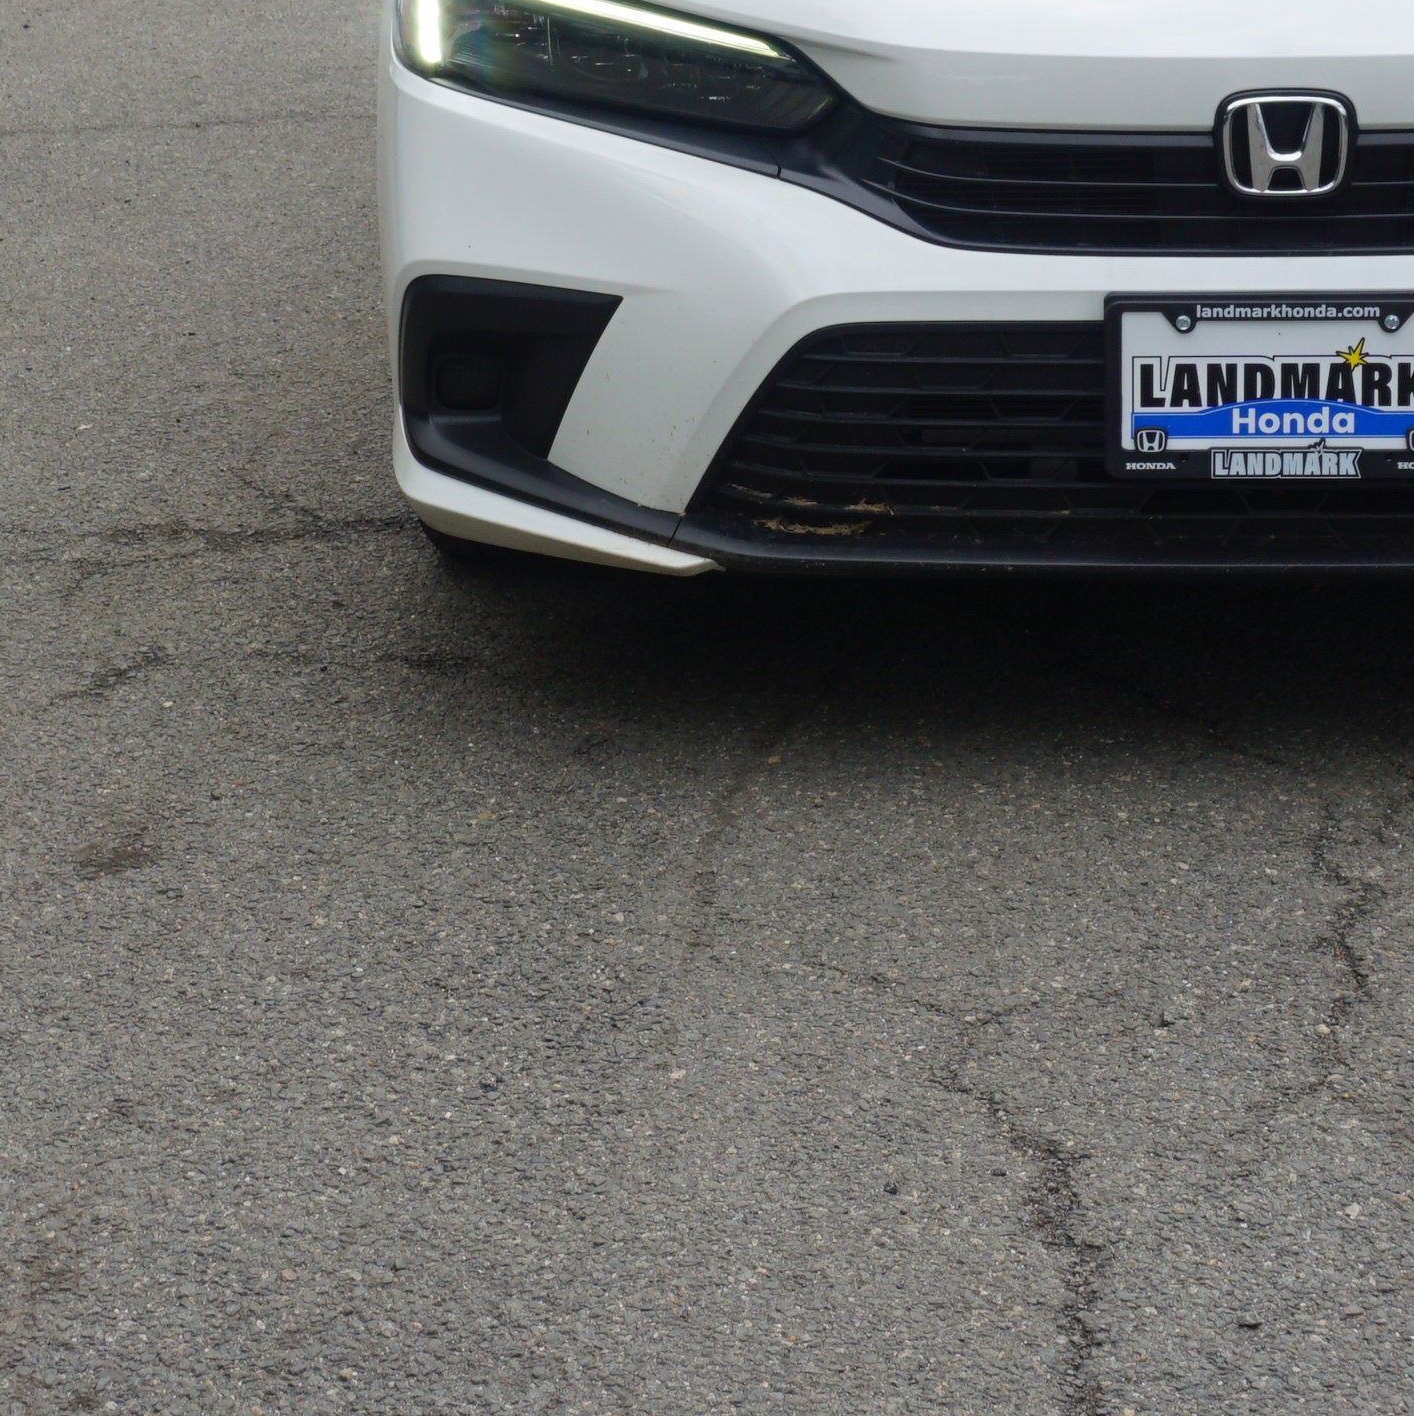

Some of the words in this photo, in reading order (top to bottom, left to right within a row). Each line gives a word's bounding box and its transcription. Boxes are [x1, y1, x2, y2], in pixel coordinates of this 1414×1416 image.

[1196, 304, 1381, 318] landmarkhonda.com
[1232, 407, 1356, 434] Honda
[1125, 462, 1177, 471] HONDA
[1214, 453, 1360, 476] LANDMARK
